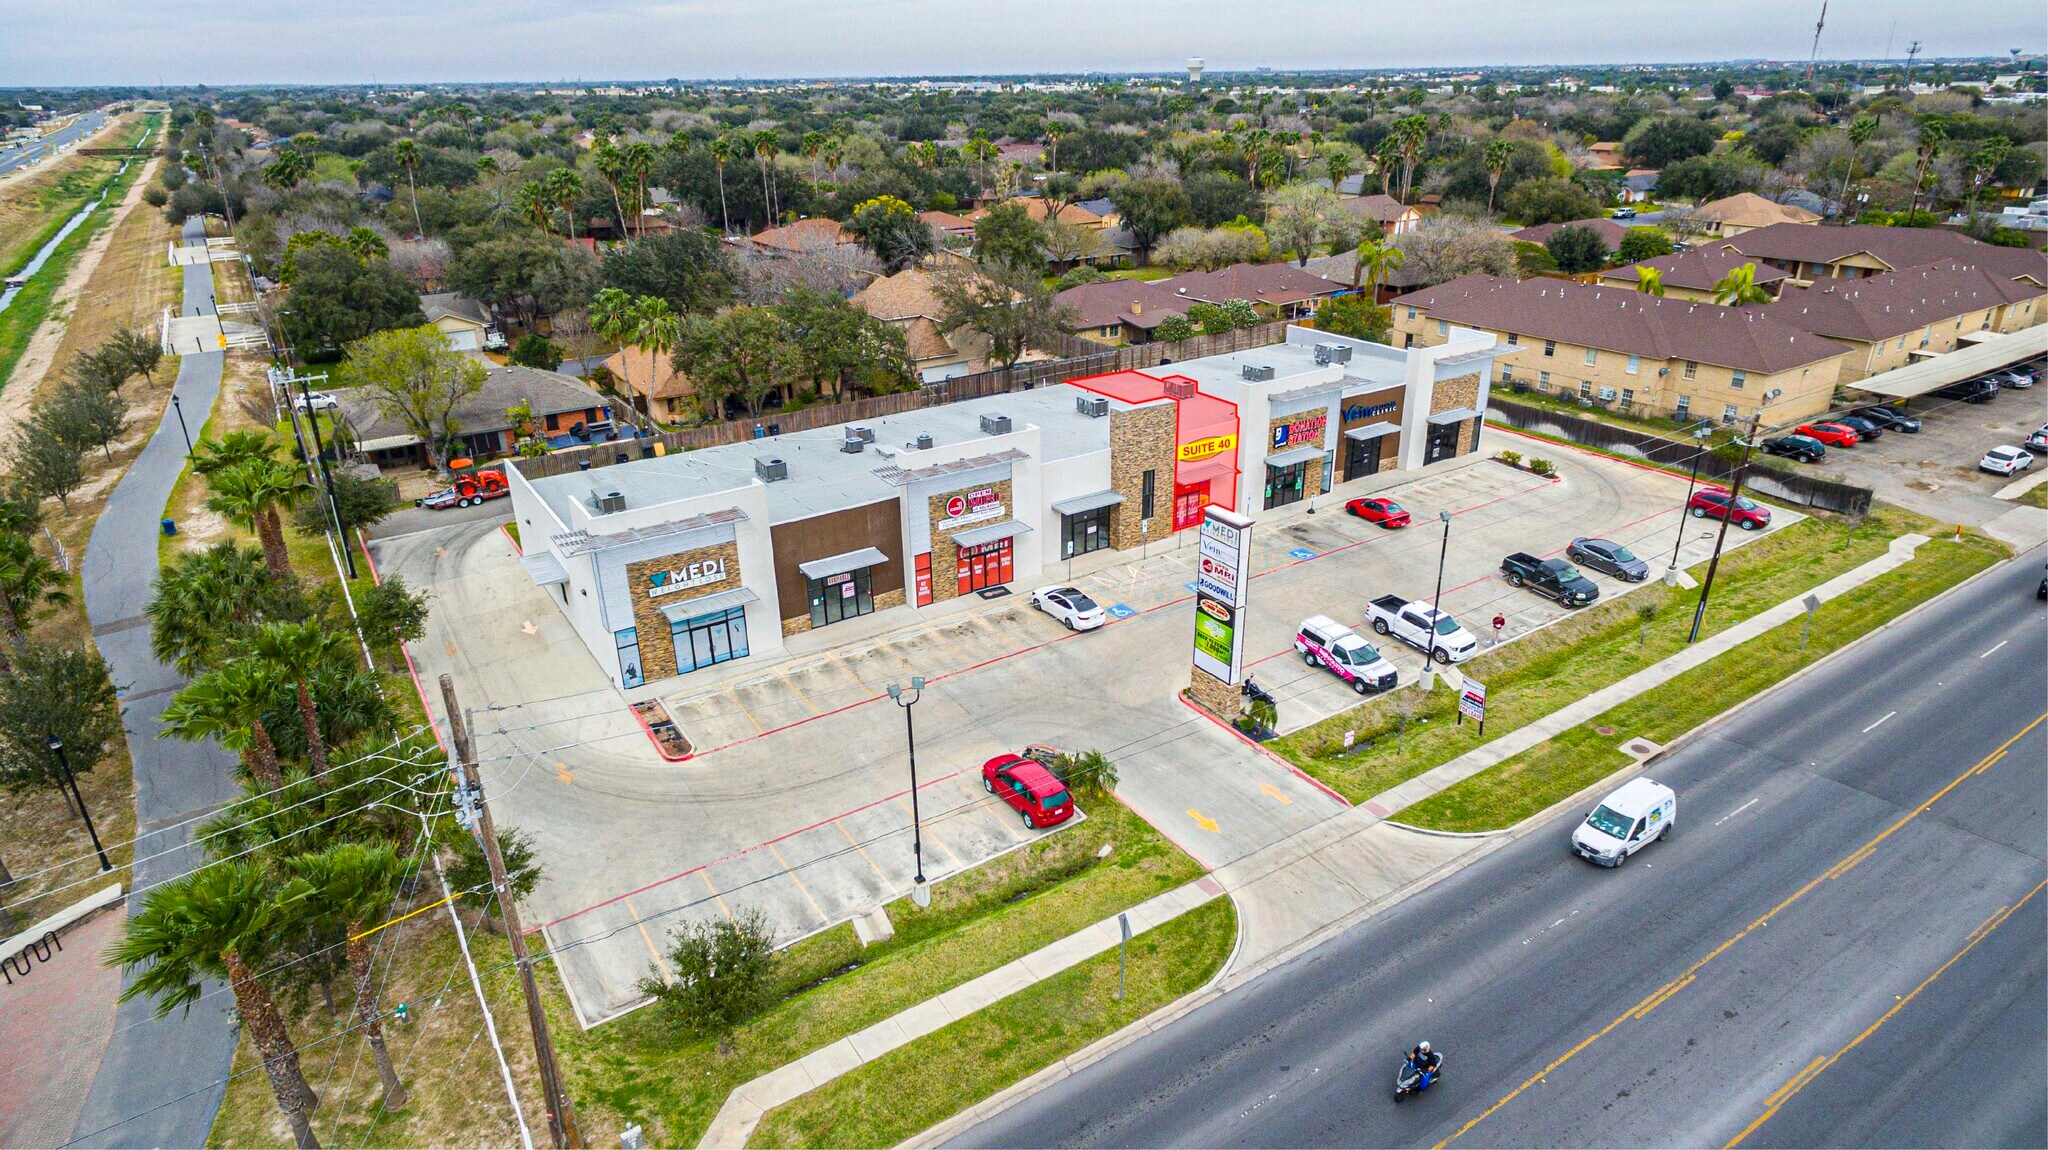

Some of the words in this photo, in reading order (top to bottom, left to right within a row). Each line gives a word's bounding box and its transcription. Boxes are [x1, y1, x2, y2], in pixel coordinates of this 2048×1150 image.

[1289, 415, 1326, 434] DONATION
[1288, 429, 1320, 445] STATION
[968, 492, 1000, 508] MRI
[1213, 522, 1238, 542] MEDI
[1203, 540, 1221, 555] Vein
[670, 557, 725, 584] MEDI
[1214, 566, 1234, 581] MRI
[1204, 580, 1234, 601] GOODWILL
